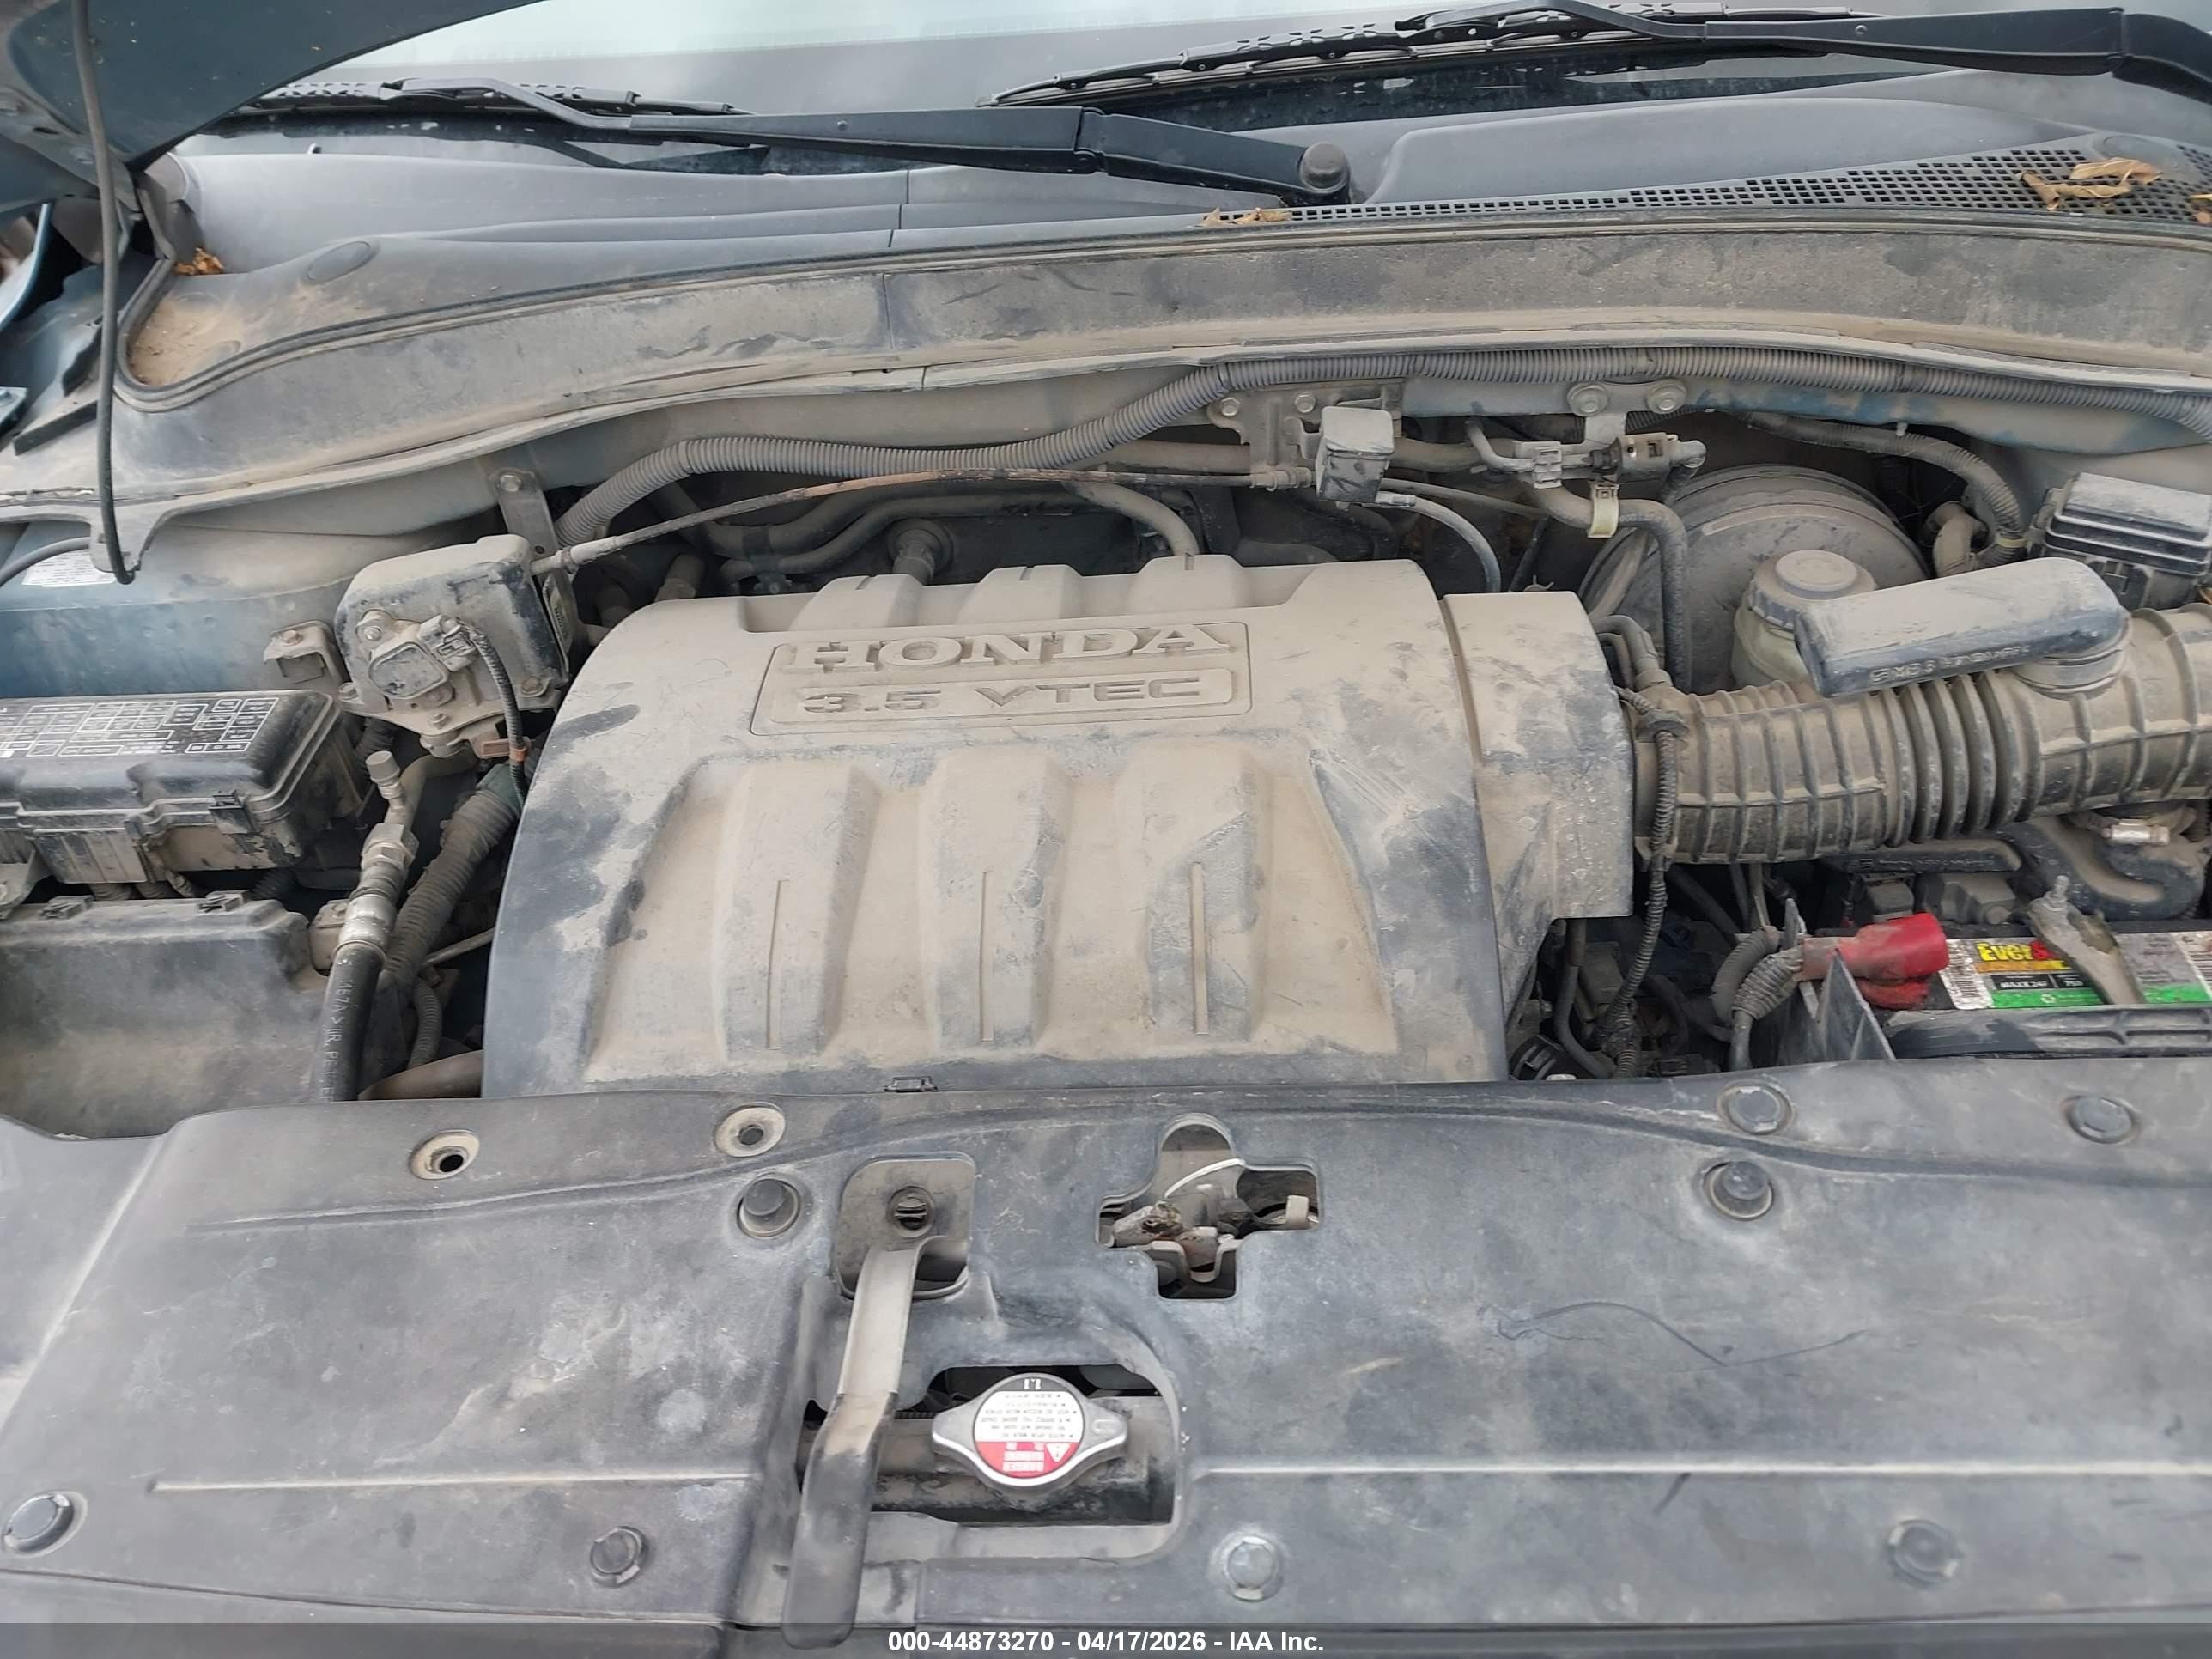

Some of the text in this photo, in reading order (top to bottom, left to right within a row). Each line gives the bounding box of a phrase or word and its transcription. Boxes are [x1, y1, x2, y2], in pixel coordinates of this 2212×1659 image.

[782, 624, 1235, 672] HONDA
[804, 676, 1201, 714] 3.5 VTEC
